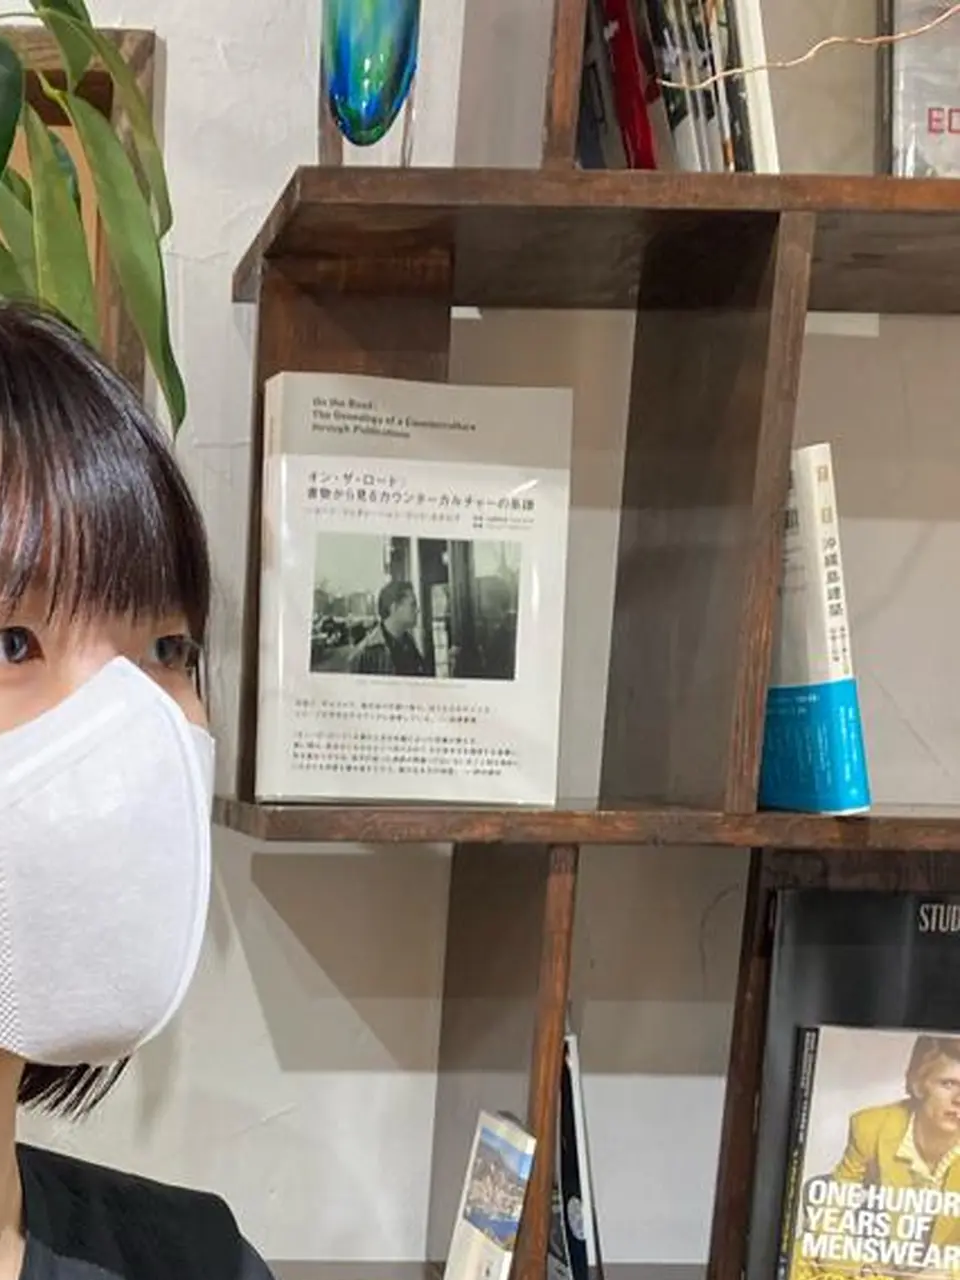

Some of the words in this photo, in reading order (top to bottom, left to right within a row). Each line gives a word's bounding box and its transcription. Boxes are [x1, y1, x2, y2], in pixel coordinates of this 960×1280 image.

[808, 1179, 865, 1208] ONE
[867, 1185, 960, 1217] HUNDR
[806, 1206, 892, 1238] YEARS
[896, 1215, 933, 1241] OF
[801, 1232, 960, 1270] MENSWEAR
